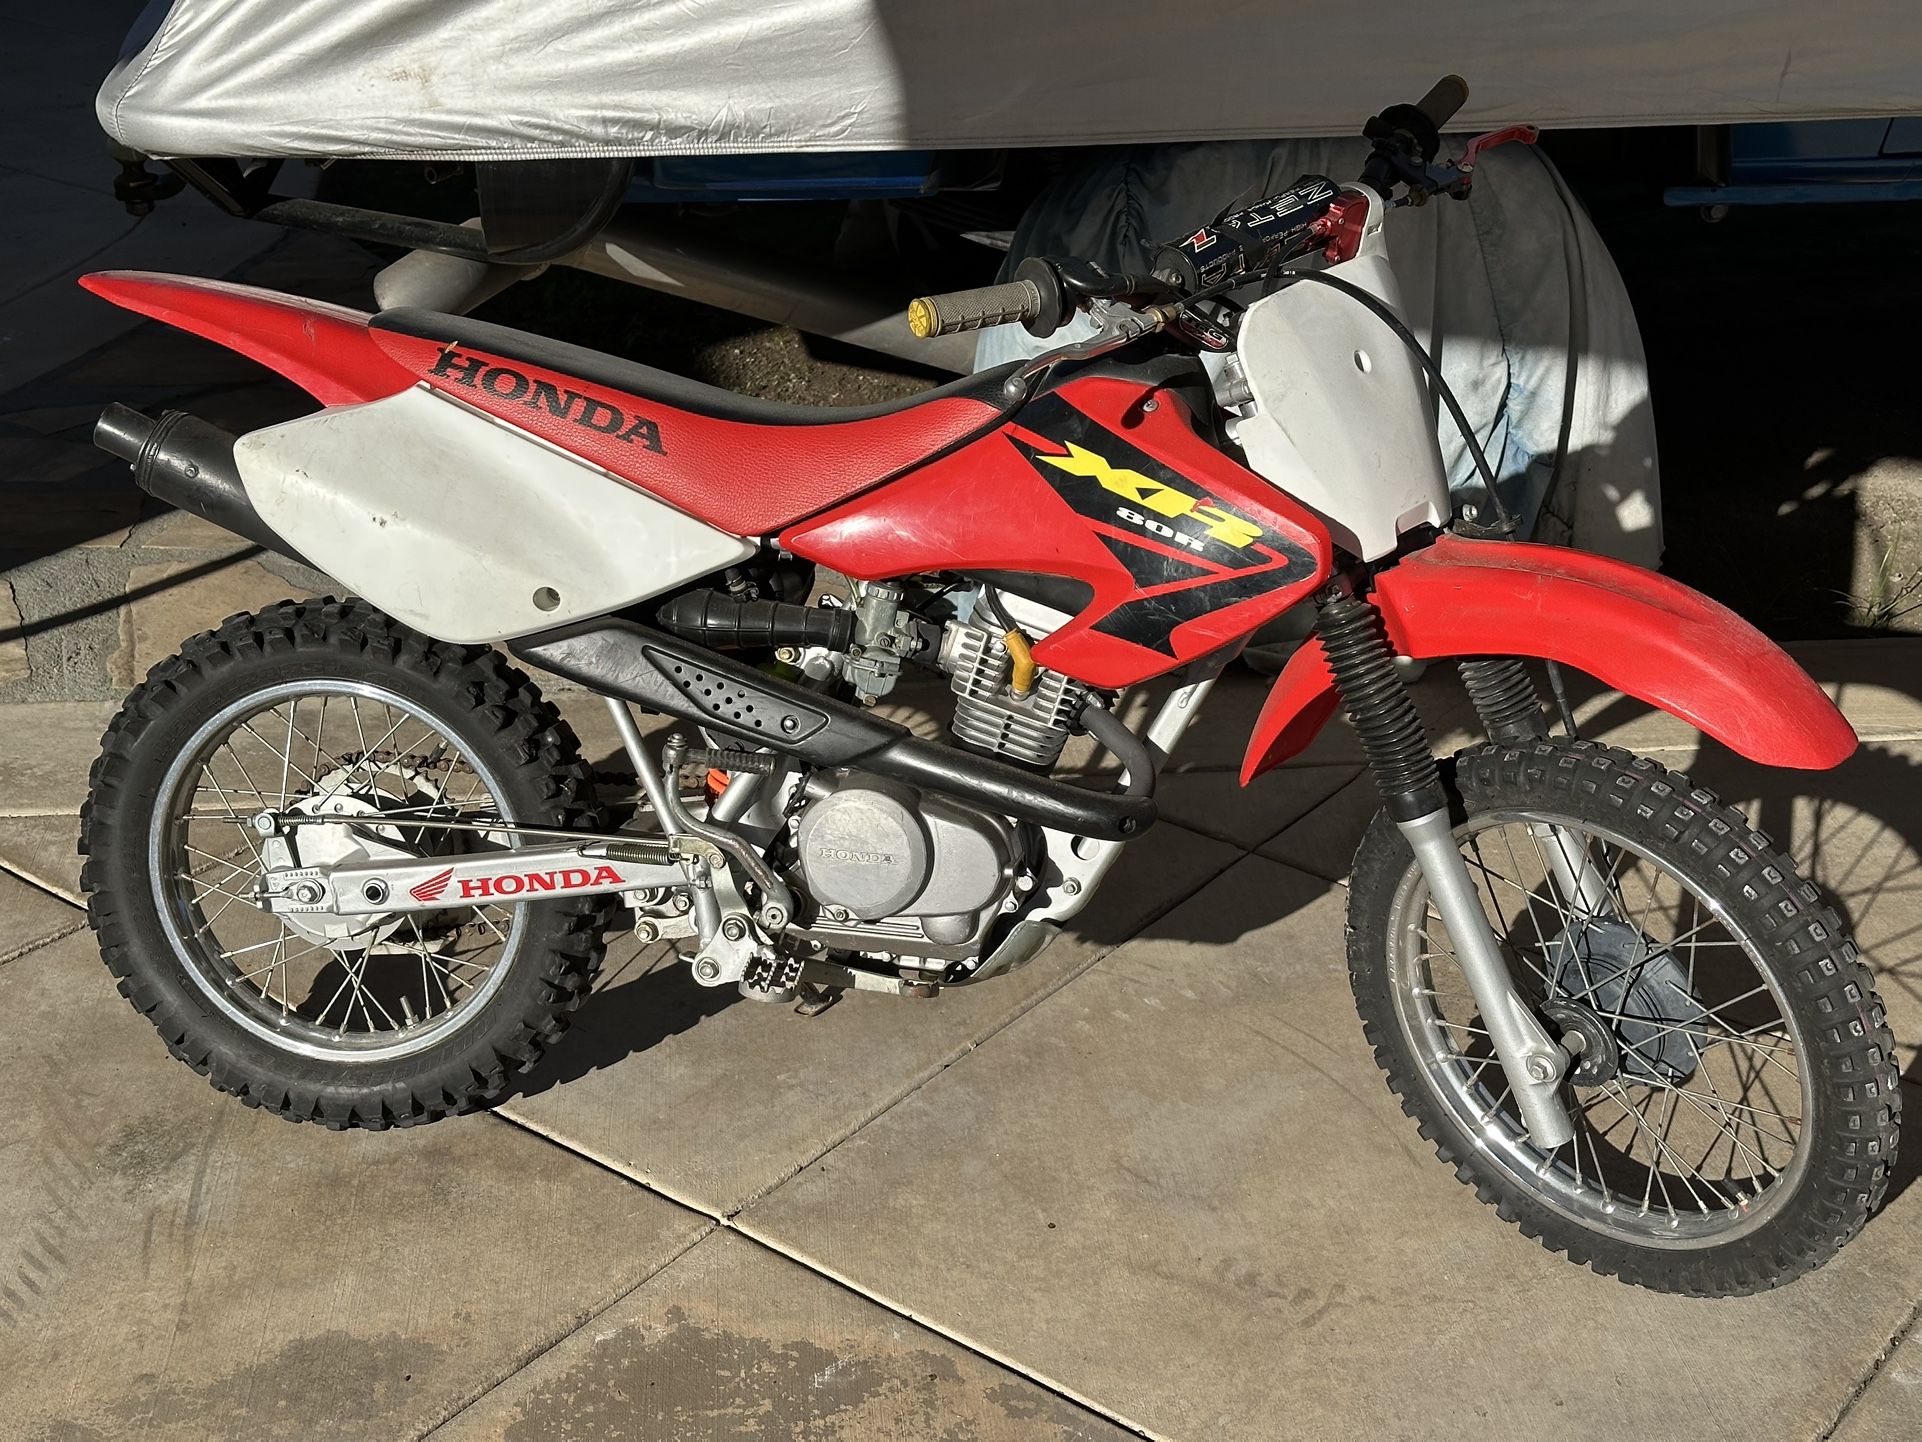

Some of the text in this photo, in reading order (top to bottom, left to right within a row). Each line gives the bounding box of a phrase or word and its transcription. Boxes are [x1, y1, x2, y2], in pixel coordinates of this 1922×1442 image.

[1198, 248, 1236, 273] PRODUCTS
[428, 346, 668, 456] HONDA
[1116, 507, 1205, 552] 80R
[820, 847, 897, 866] HONDA
[458, 865, 626, 899] HONDA
